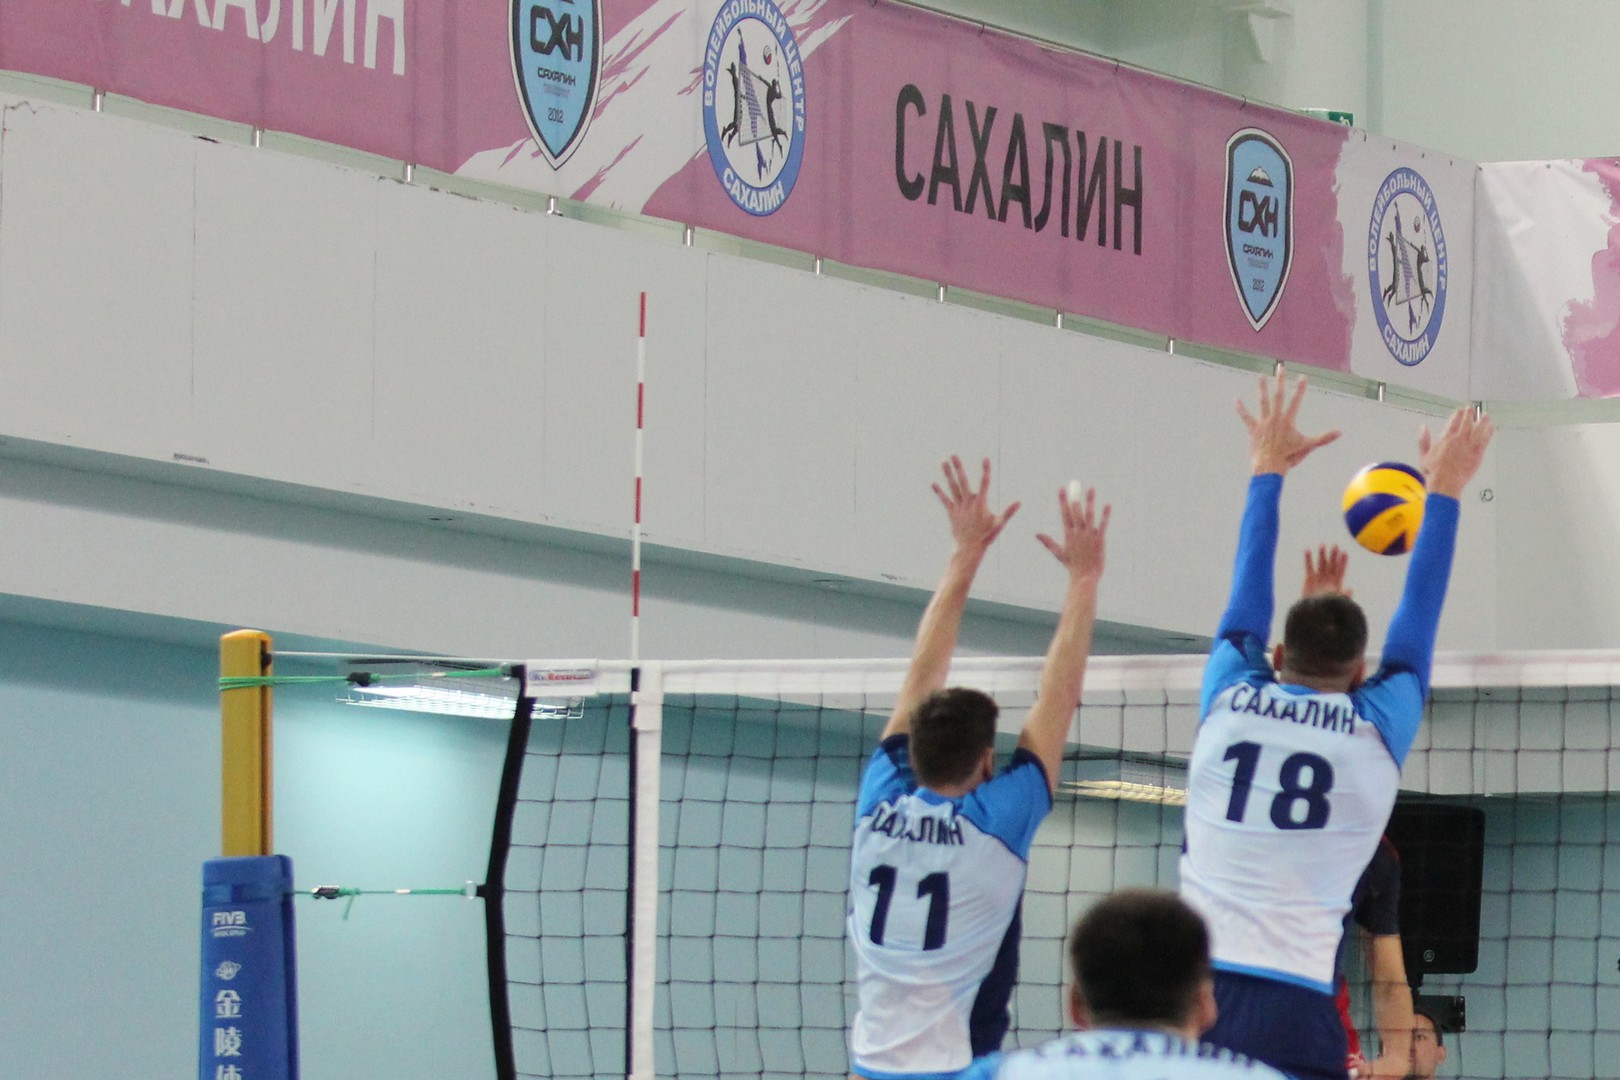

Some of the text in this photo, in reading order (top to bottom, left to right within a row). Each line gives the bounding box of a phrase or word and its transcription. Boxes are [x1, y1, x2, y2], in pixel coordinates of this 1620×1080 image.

[548, 107, 564, 124] 2012
[784, 40, 805, 132] ЦЕНТР
[722, 167, 785, 212] САХАЛИН
[895, 83, 1143, 256] САХАЛИН
[1430, 206, 1447, 291] ЦЕНТР
[1384, 323, 1430, 362] САХАЛИН
[1230, 685, 1355, 734] САХАЛИН
[1223, 740, 1335, 830] 18
[213, 911, 246, 925] FIVB
[868, 864, 950, 951] 11
